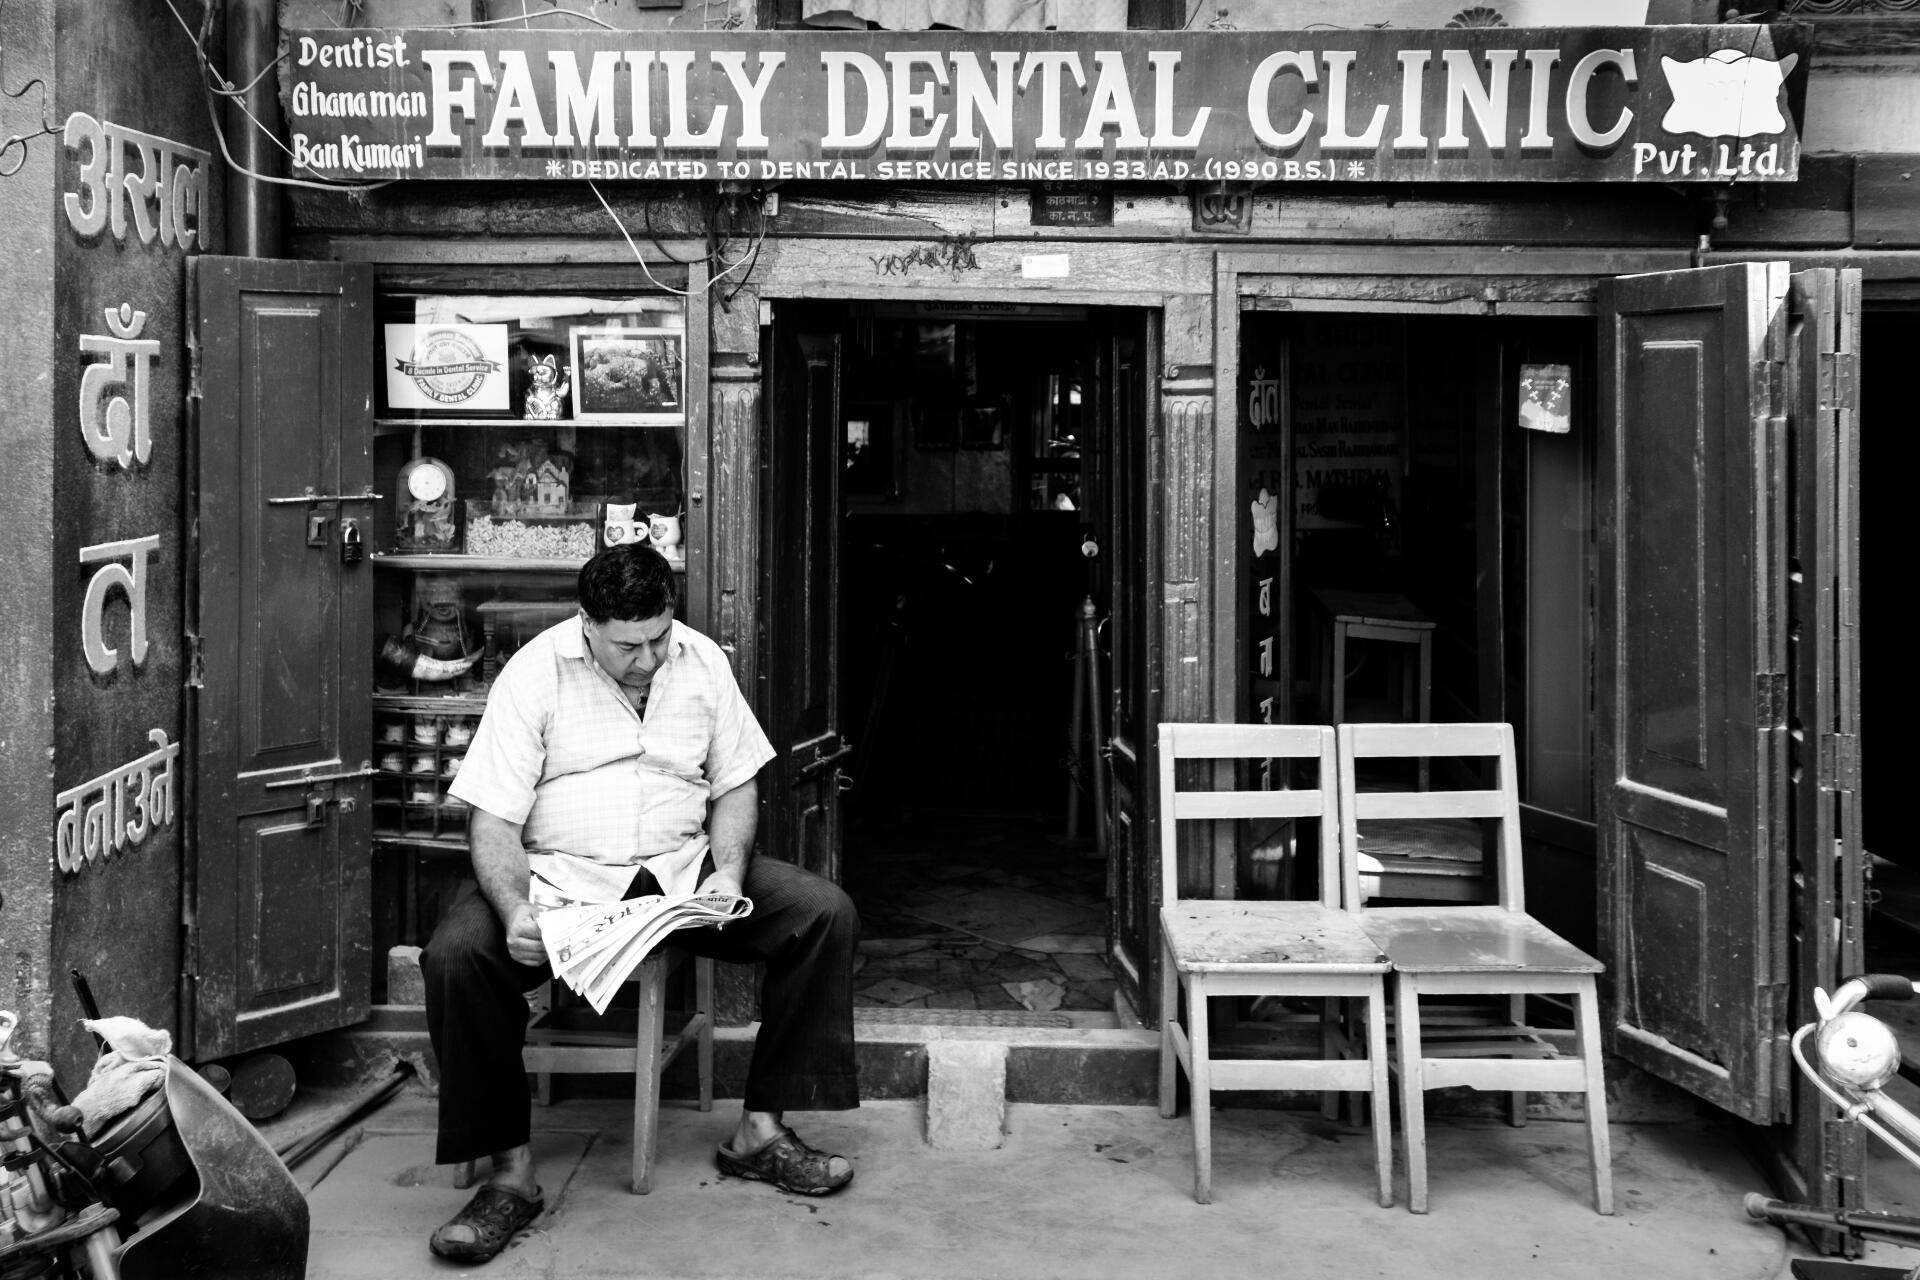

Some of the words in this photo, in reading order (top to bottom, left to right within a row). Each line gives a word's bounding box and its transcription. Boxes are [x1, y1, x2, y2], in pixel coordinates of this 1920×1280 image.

[298, 35, 411, 68] Dentist
[421, 50, 786, 147] FAMILY
[820, 50, 1212, 148] DENTAL
[1247, 48, 1638, 150] CLINIC
[63, 111, 212, 251] असल
[571, 159, 708, 180] DEDICATED
[716, 160, 751, 180] TO
[760, 159, 866, 180] DENTAL
[875, 158, 996, 181] SERVICE
[1002, 159, 1078, 181] SINCE
[1083, 160, 1147, 180] 1933
[1717, 143, 1786, 176] Ltd.
[55, 727, 180, 874] बनाउने
